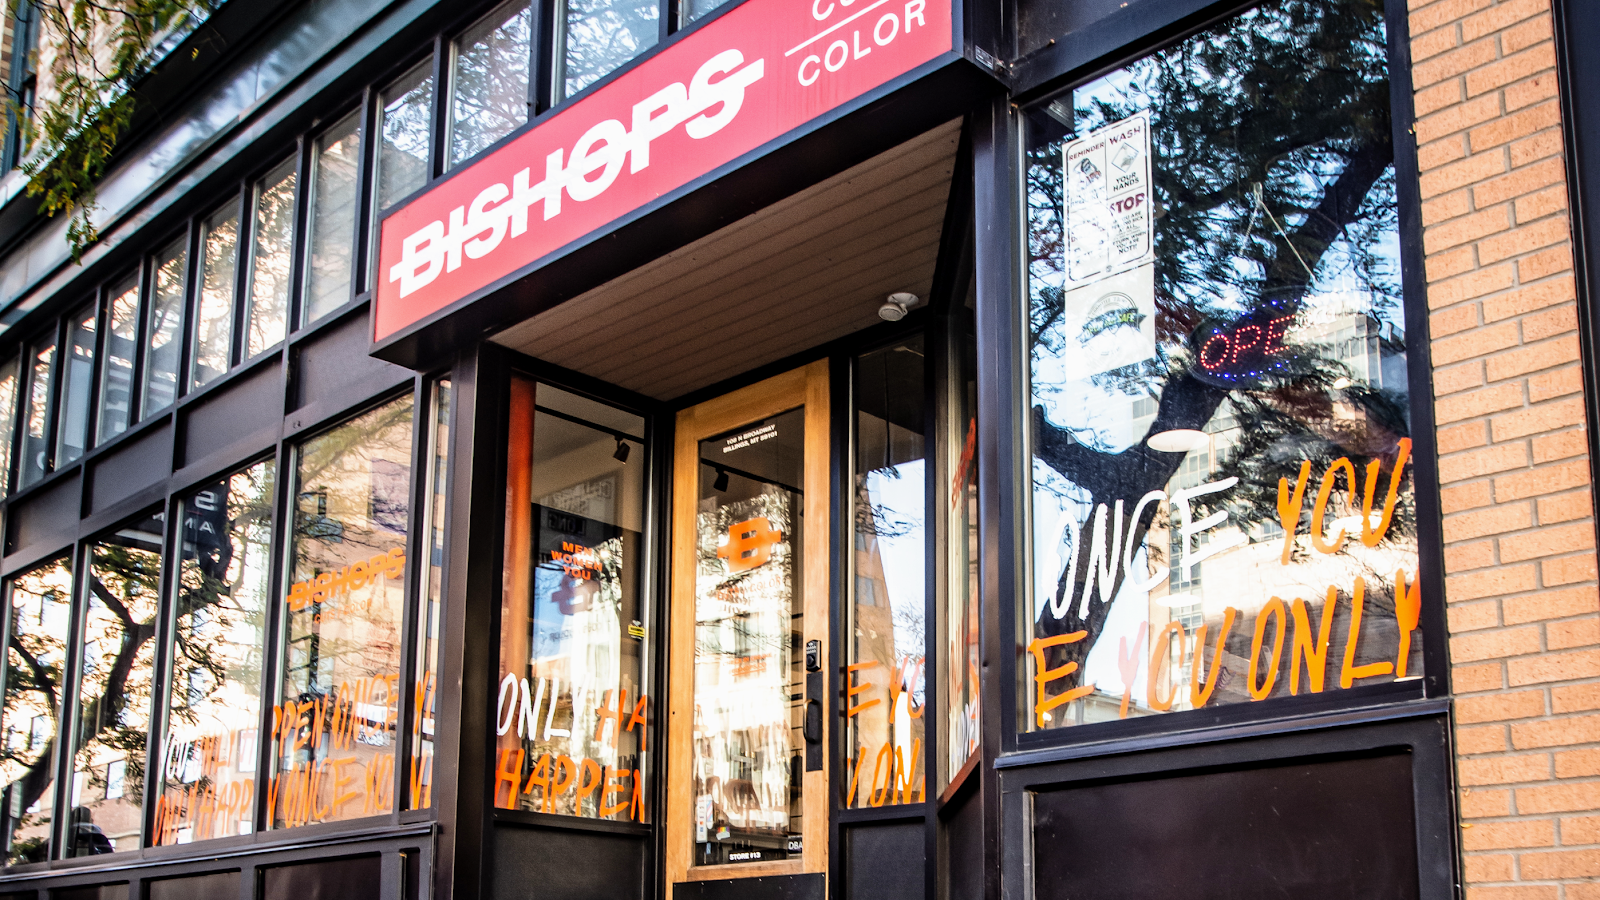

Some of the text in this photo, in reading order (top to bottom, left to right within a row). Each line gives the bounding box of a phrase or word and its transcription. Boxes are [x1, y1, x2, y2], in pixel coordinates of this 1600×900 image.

[798, 0, 926, 86] COLOR
[1068, 142, 1105, 161] REMINDER
[1109, 126, 1141, 145] WASH
[389, 49, 764, 298] BISHOPS
[1113, 178, 1140, 192] HANDS
[1200, 315, 1296, 369] OPE
[562, 541, 594, 557] MEN
[717, 516, 781, 573] B
[1042, 437, 1413, 620] ONCE YOU
[286, 547, 406, 612] BISHOPS
[551, 550, 603, 573] WOMEN
[562, 565, 592, 581] YOU
[1028, 566, 1420, 728] E YOU ONLY
[497, 672, 590, 742] ONLY
[284, 756, 357, 829] ONCE
[729, 853, 750, 861] STORE
